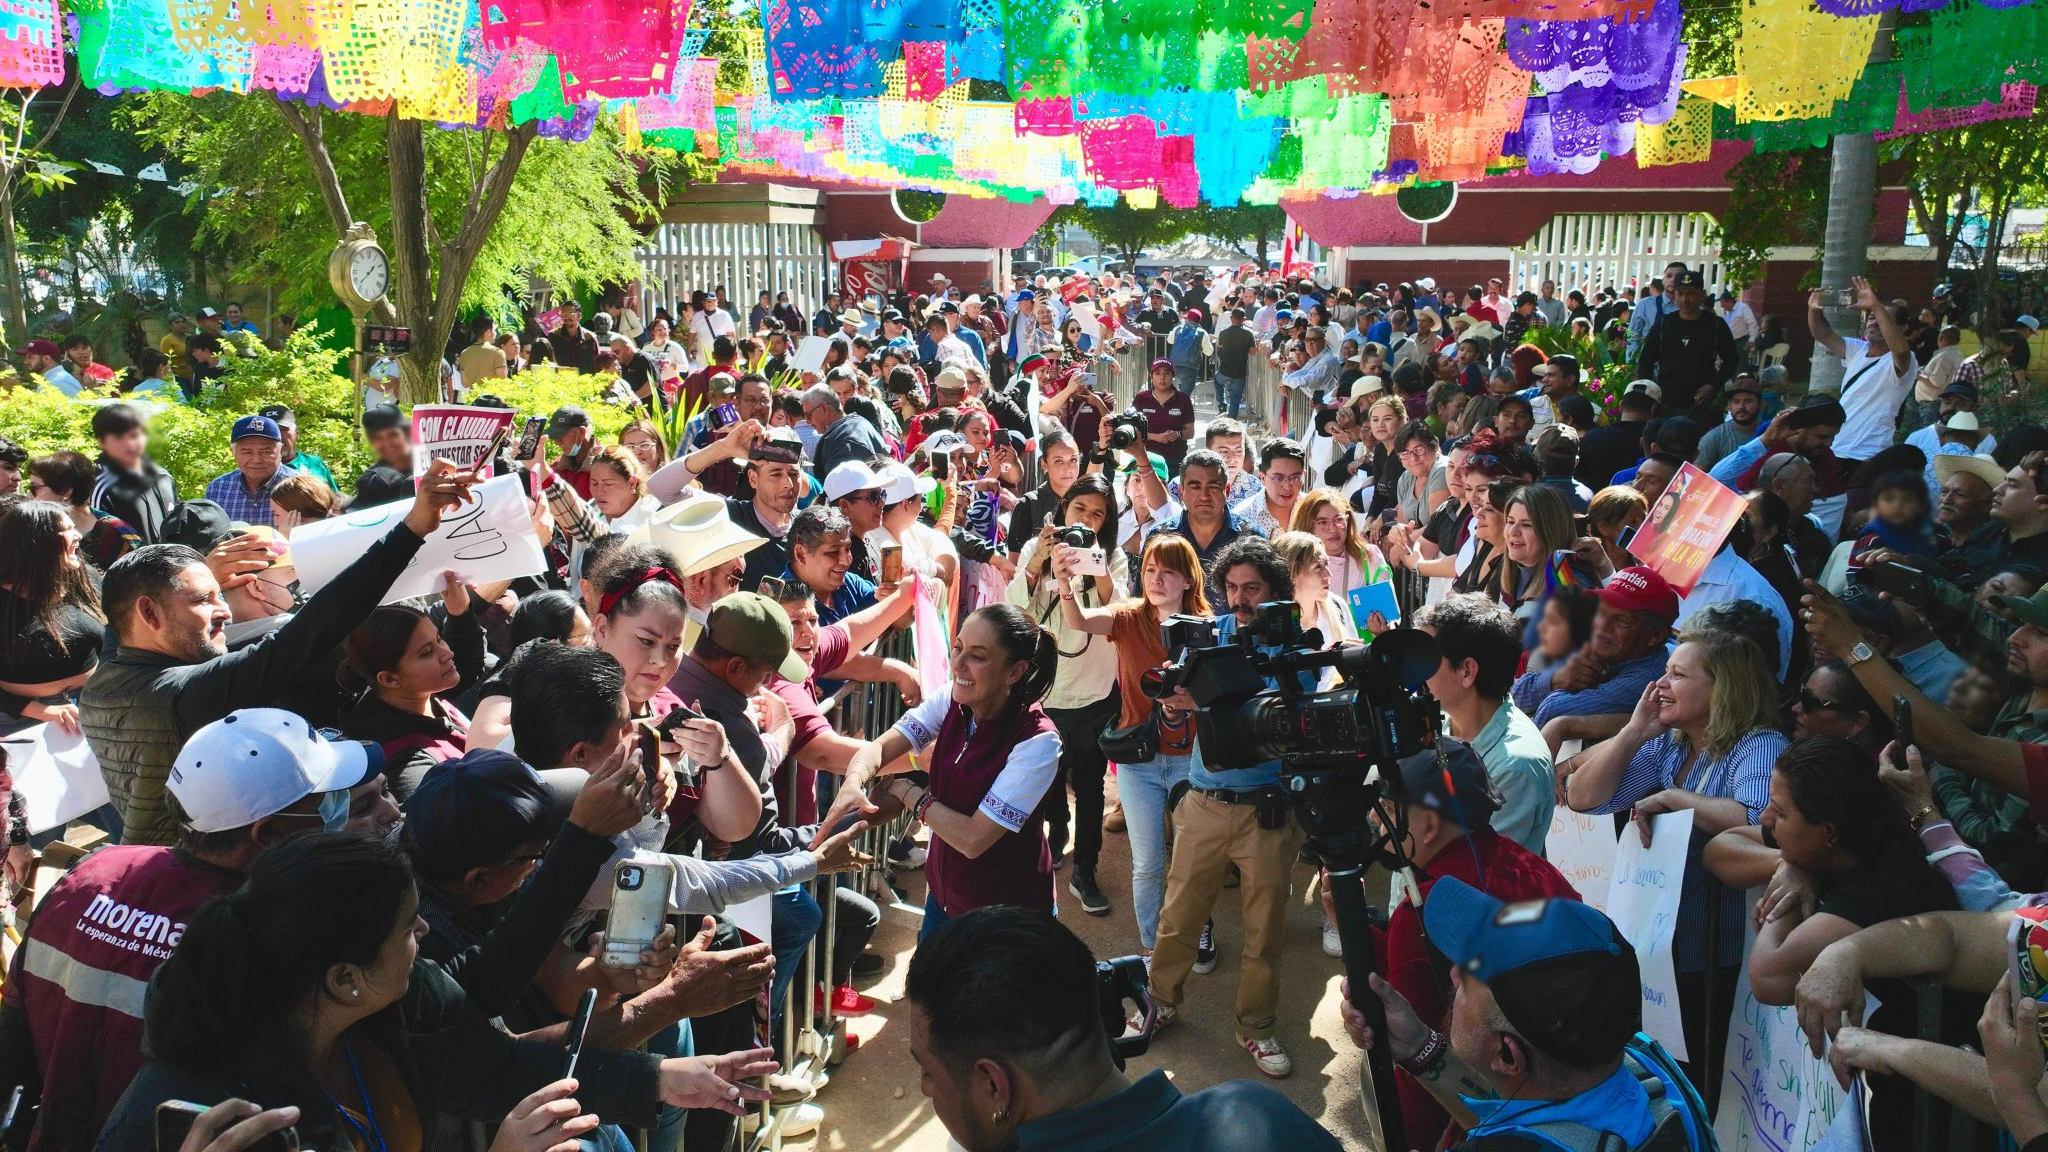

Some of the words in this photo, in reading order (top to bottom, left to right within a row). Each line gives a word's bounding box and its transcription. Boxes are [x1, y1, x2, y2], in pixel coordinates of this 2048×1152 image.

[419, 417, 442, 443] CON
[442, 416, 499, 440] CLAUDIA
[473, 445, 489, 462] SE
[83, 893, 188, 947] morena
[76, 918, 84, 931] La
[84, 925, 127, 949] esperanza
[127, 939, 140, 952] de
[142, 943, 174, 960] Méxi
